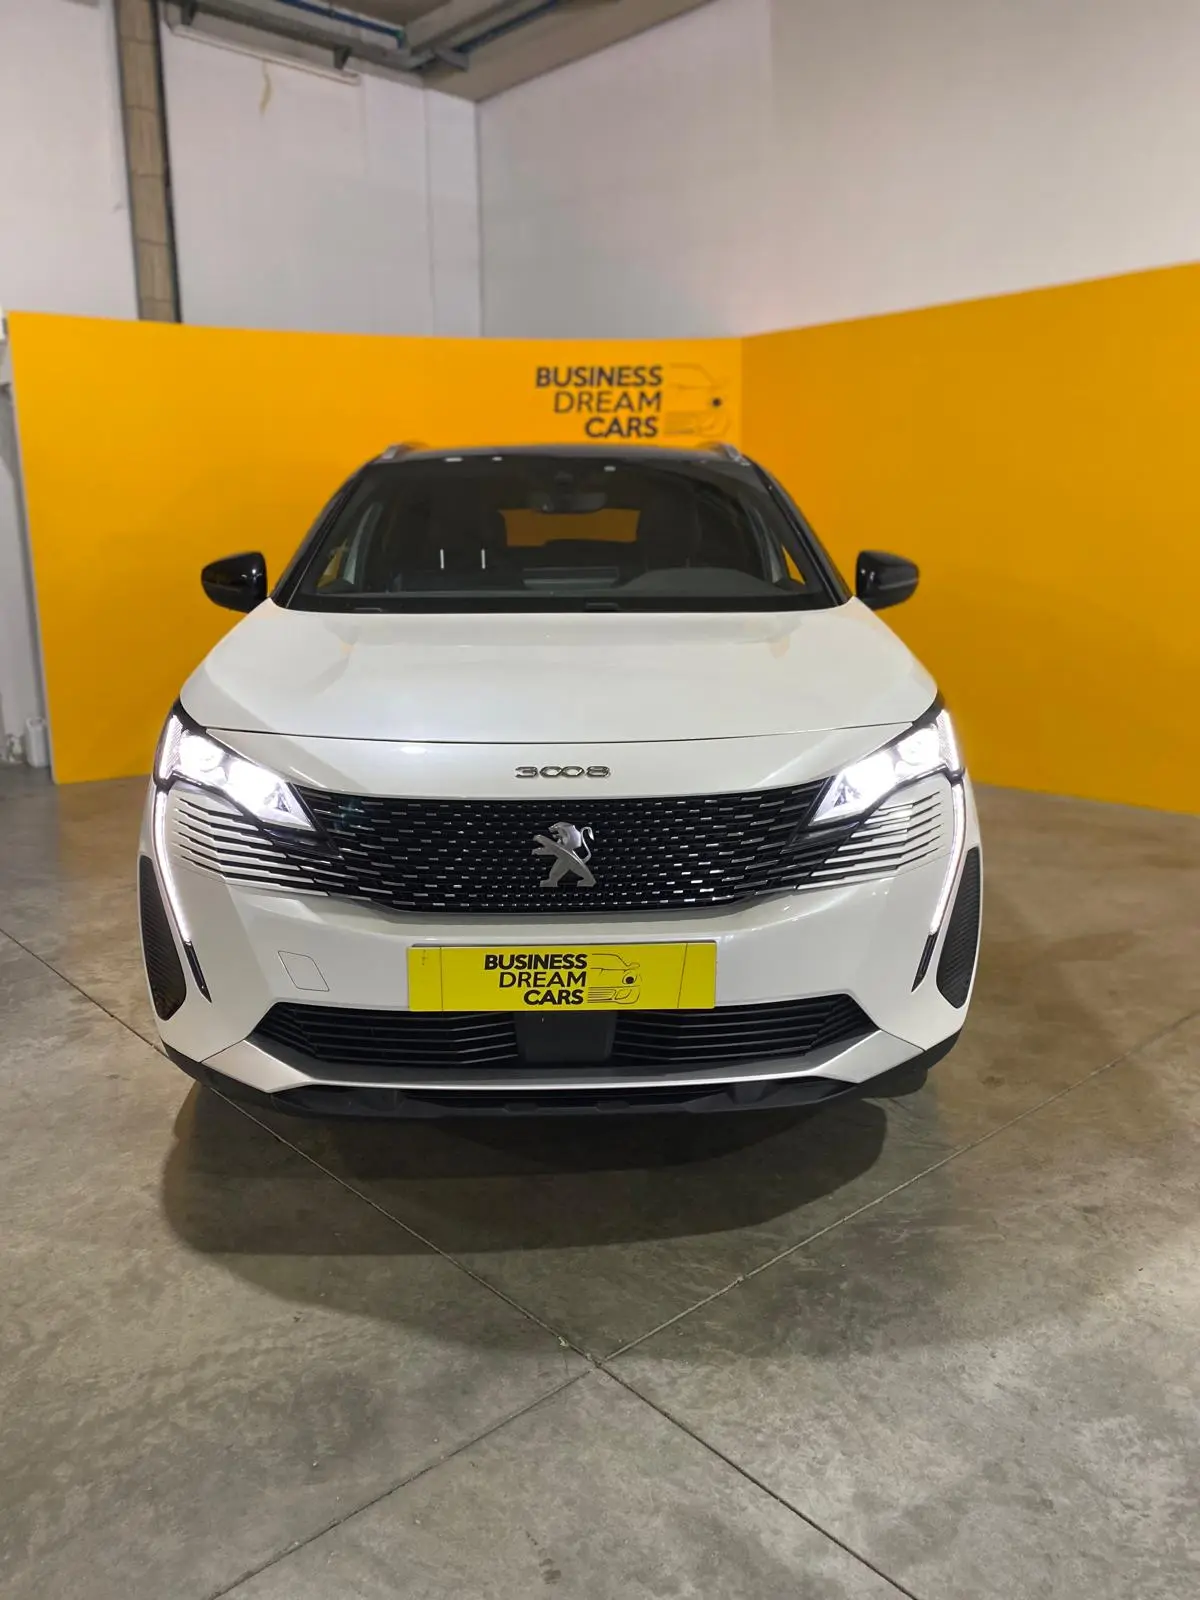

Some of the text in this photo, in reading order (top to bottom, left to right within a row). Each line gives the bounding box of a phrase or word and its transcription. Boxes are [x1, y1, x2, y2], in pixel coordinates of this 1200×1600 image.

[535, 366, 663, 387] BUSINESS
[553, 390, 662, 413] DREAM
[584, 416, 659, 438] CARS
[514, 765, 611, 778] 3008
[484, 953, 588, 971] BUSINESS
[498, 971, 587, 988] DREAM
[523, 988, 585, 1006] CARS
